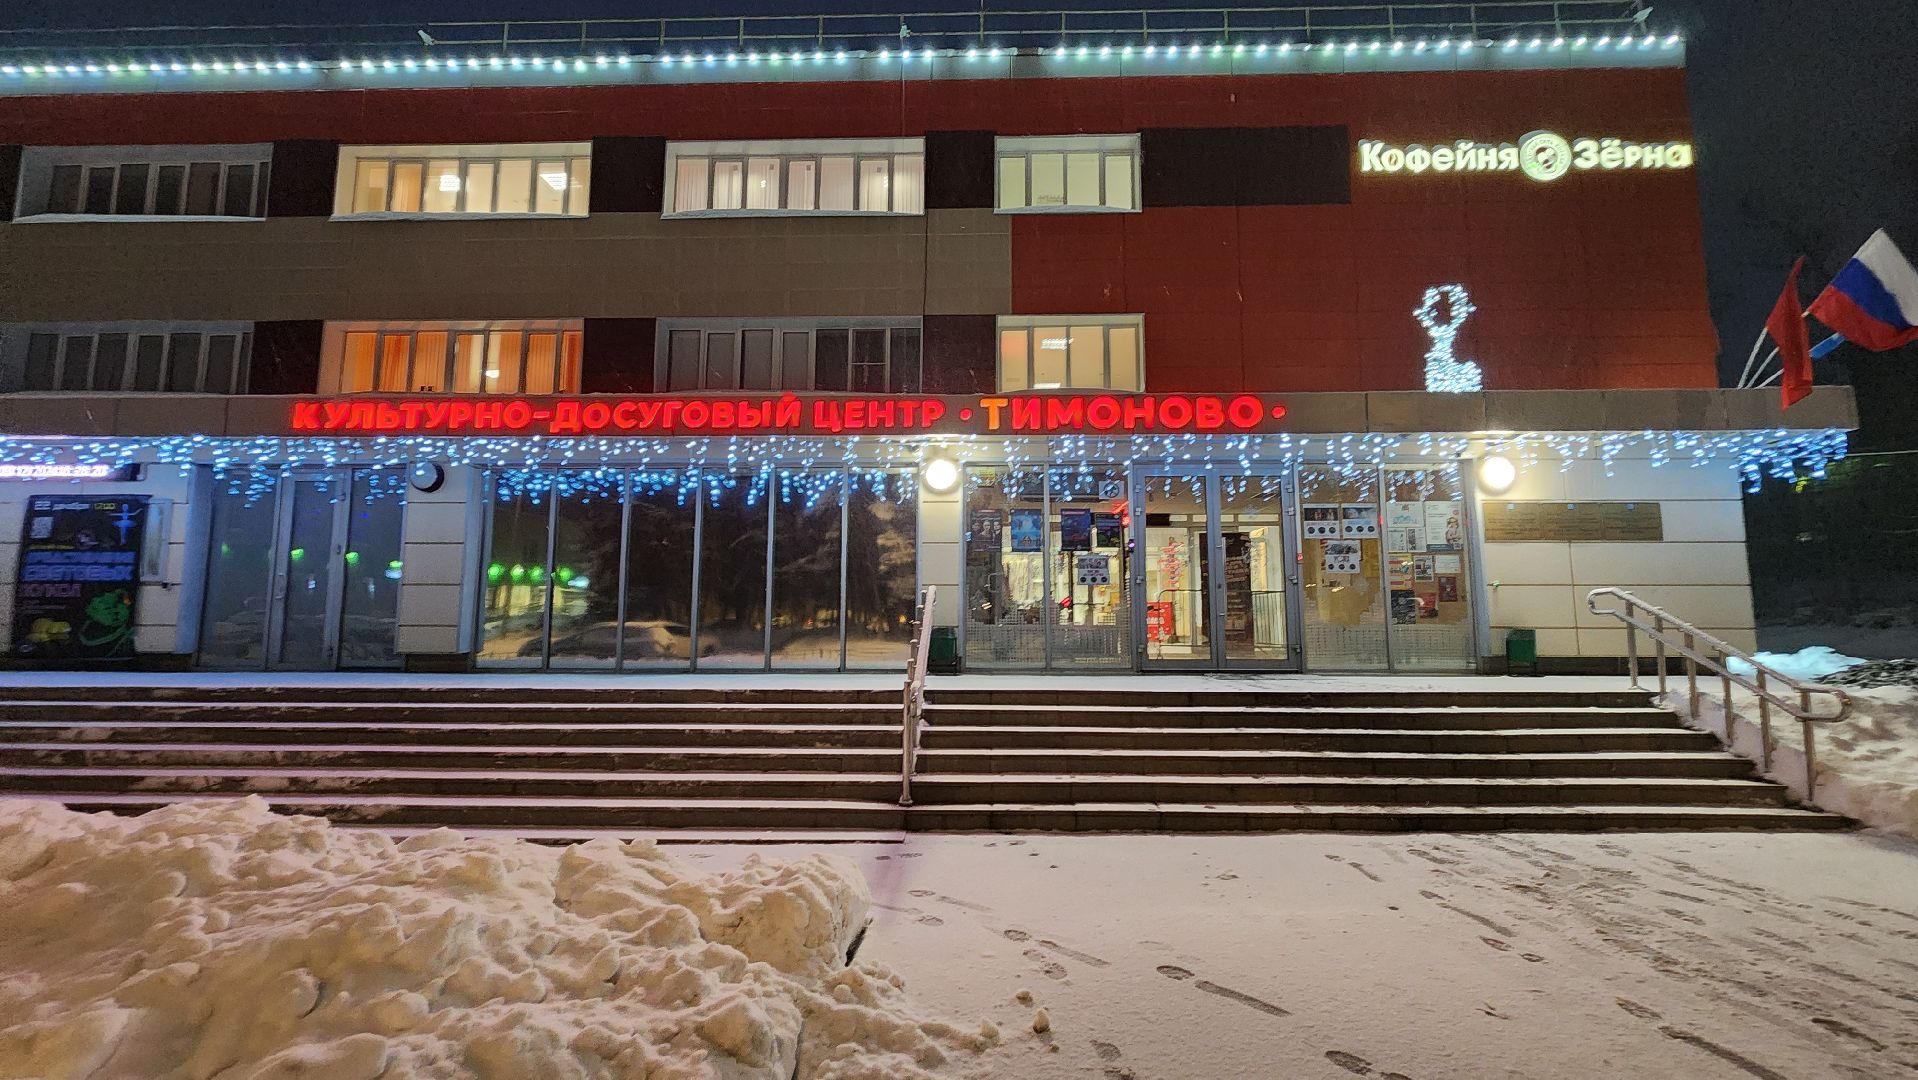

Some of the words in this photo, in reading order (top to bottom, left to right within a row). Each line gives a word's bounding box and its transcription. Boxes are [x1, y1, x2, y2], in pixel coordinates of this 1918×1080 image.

[1359, 140, 1520, 173] Кофейня
[1573, 139, 1694, 169] Зёрна
[291, 390, 801, 433] КУЛЬТУРНО-ДОСУГОВЫЙ
[813, 400, 946, 432] ЦЕНТР
[979, 396, 1264, 430] ТИМОНОВО
